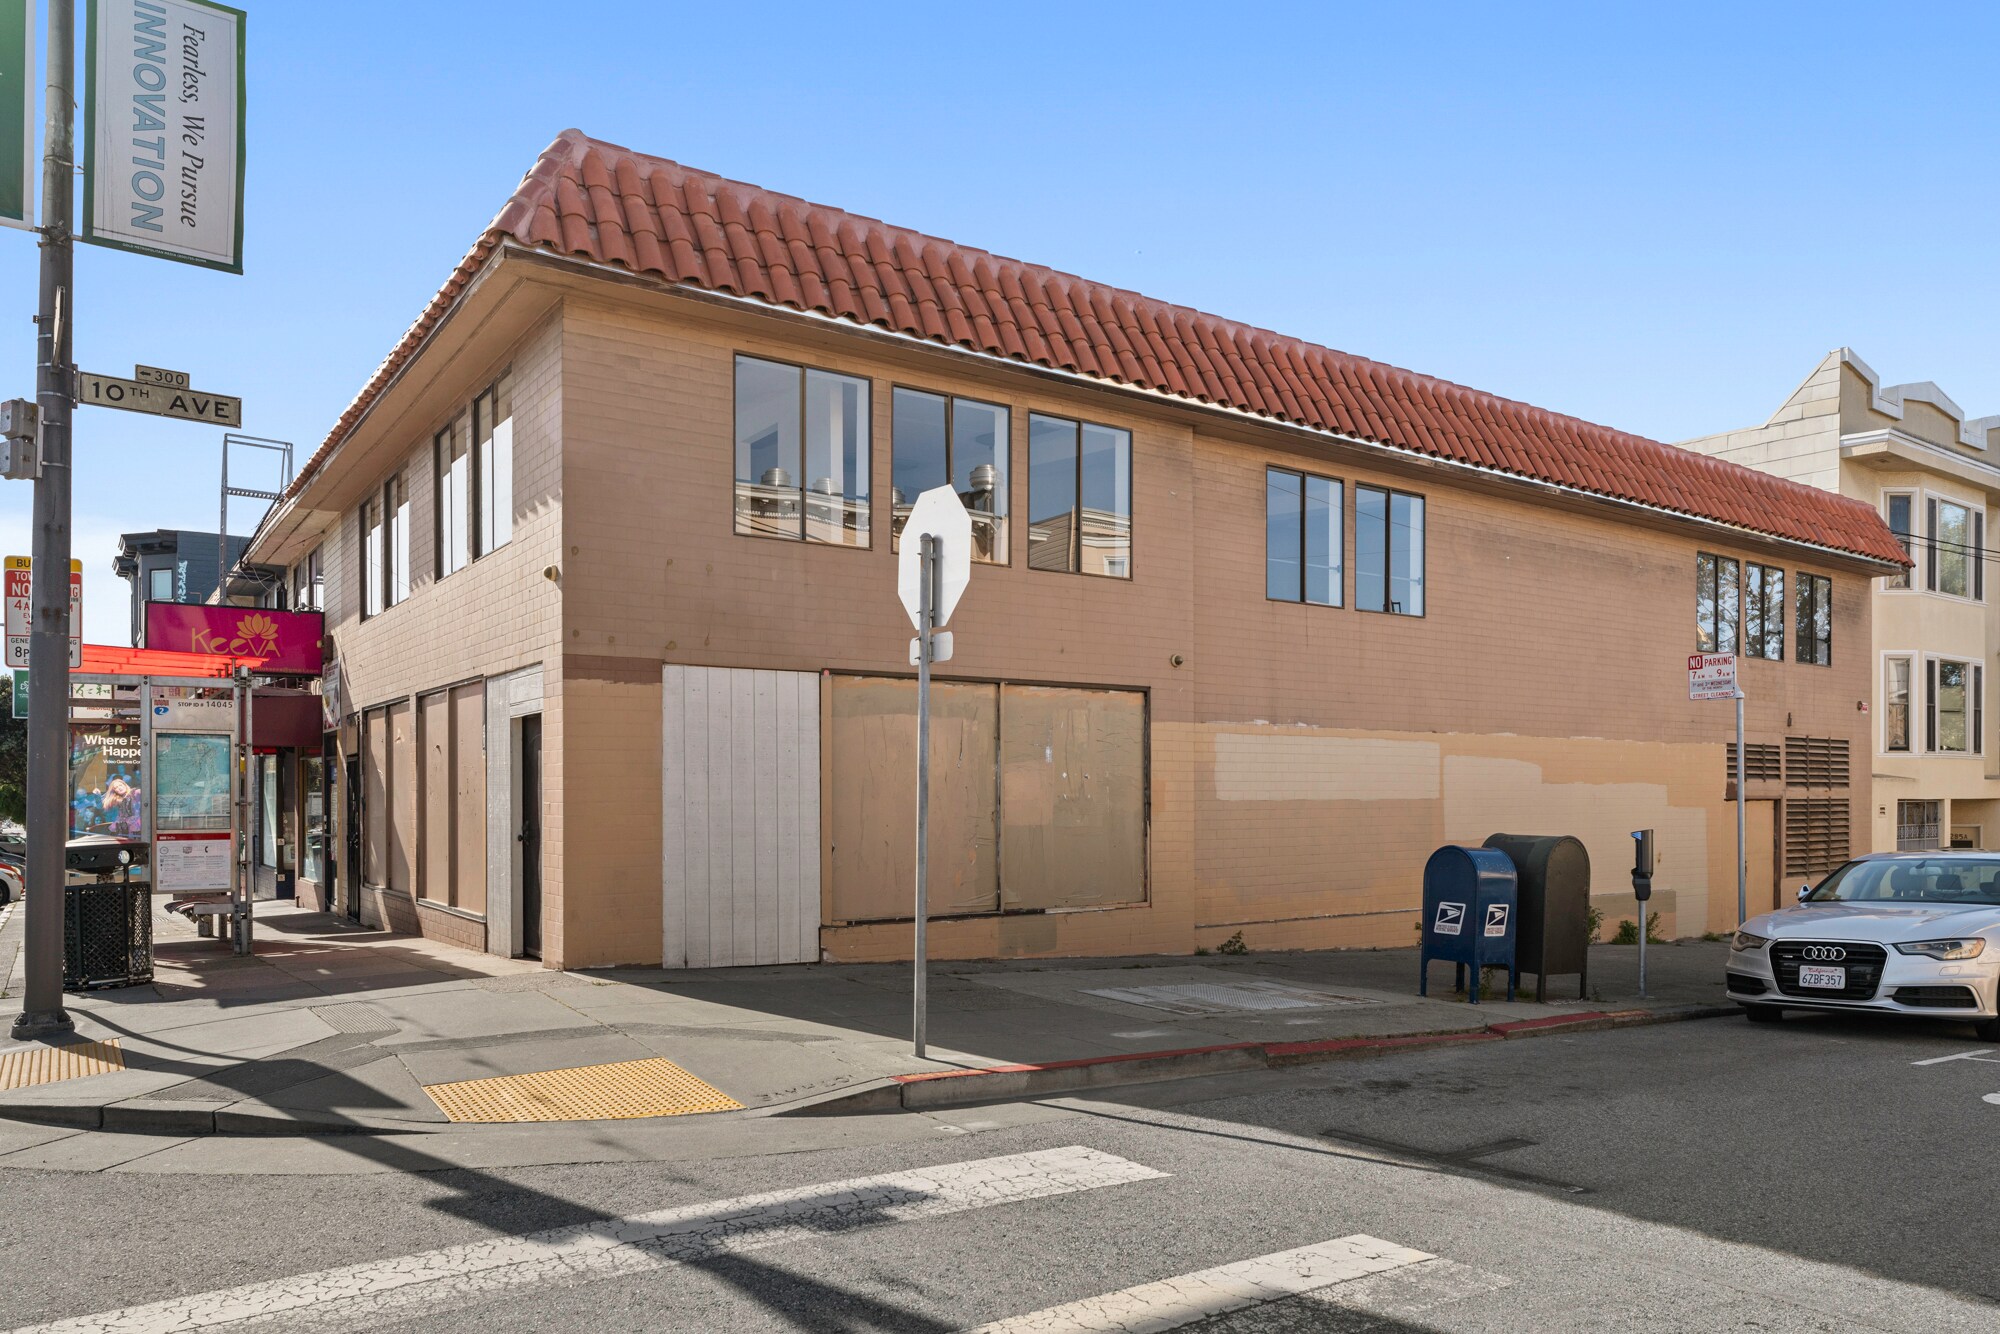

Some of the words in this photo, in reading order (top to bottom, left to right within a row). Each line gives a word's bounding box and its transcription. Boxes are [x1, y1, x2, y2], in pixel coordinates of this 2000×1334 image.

[178, 23, 207, 104] Fearless,
[131, 0, 167, 233] INNOVATION
[182, 115, 205, 146] We
[180, 151, 205, 228] Pursue
[155, 371, 184, 385] 300
[92, 381, 149, 401] 10TH
[169, 395, 229, 418] AVE
[16, 559, 31, 568] BU
[11, 582, 31, 596] NO
[1690, 656, 1701, 669] NO
[1704, 656, 1732, 667] PARKING
[84, 735, 128, 745] Where
[1802, 973, 1842, 986] 6ZBF357
